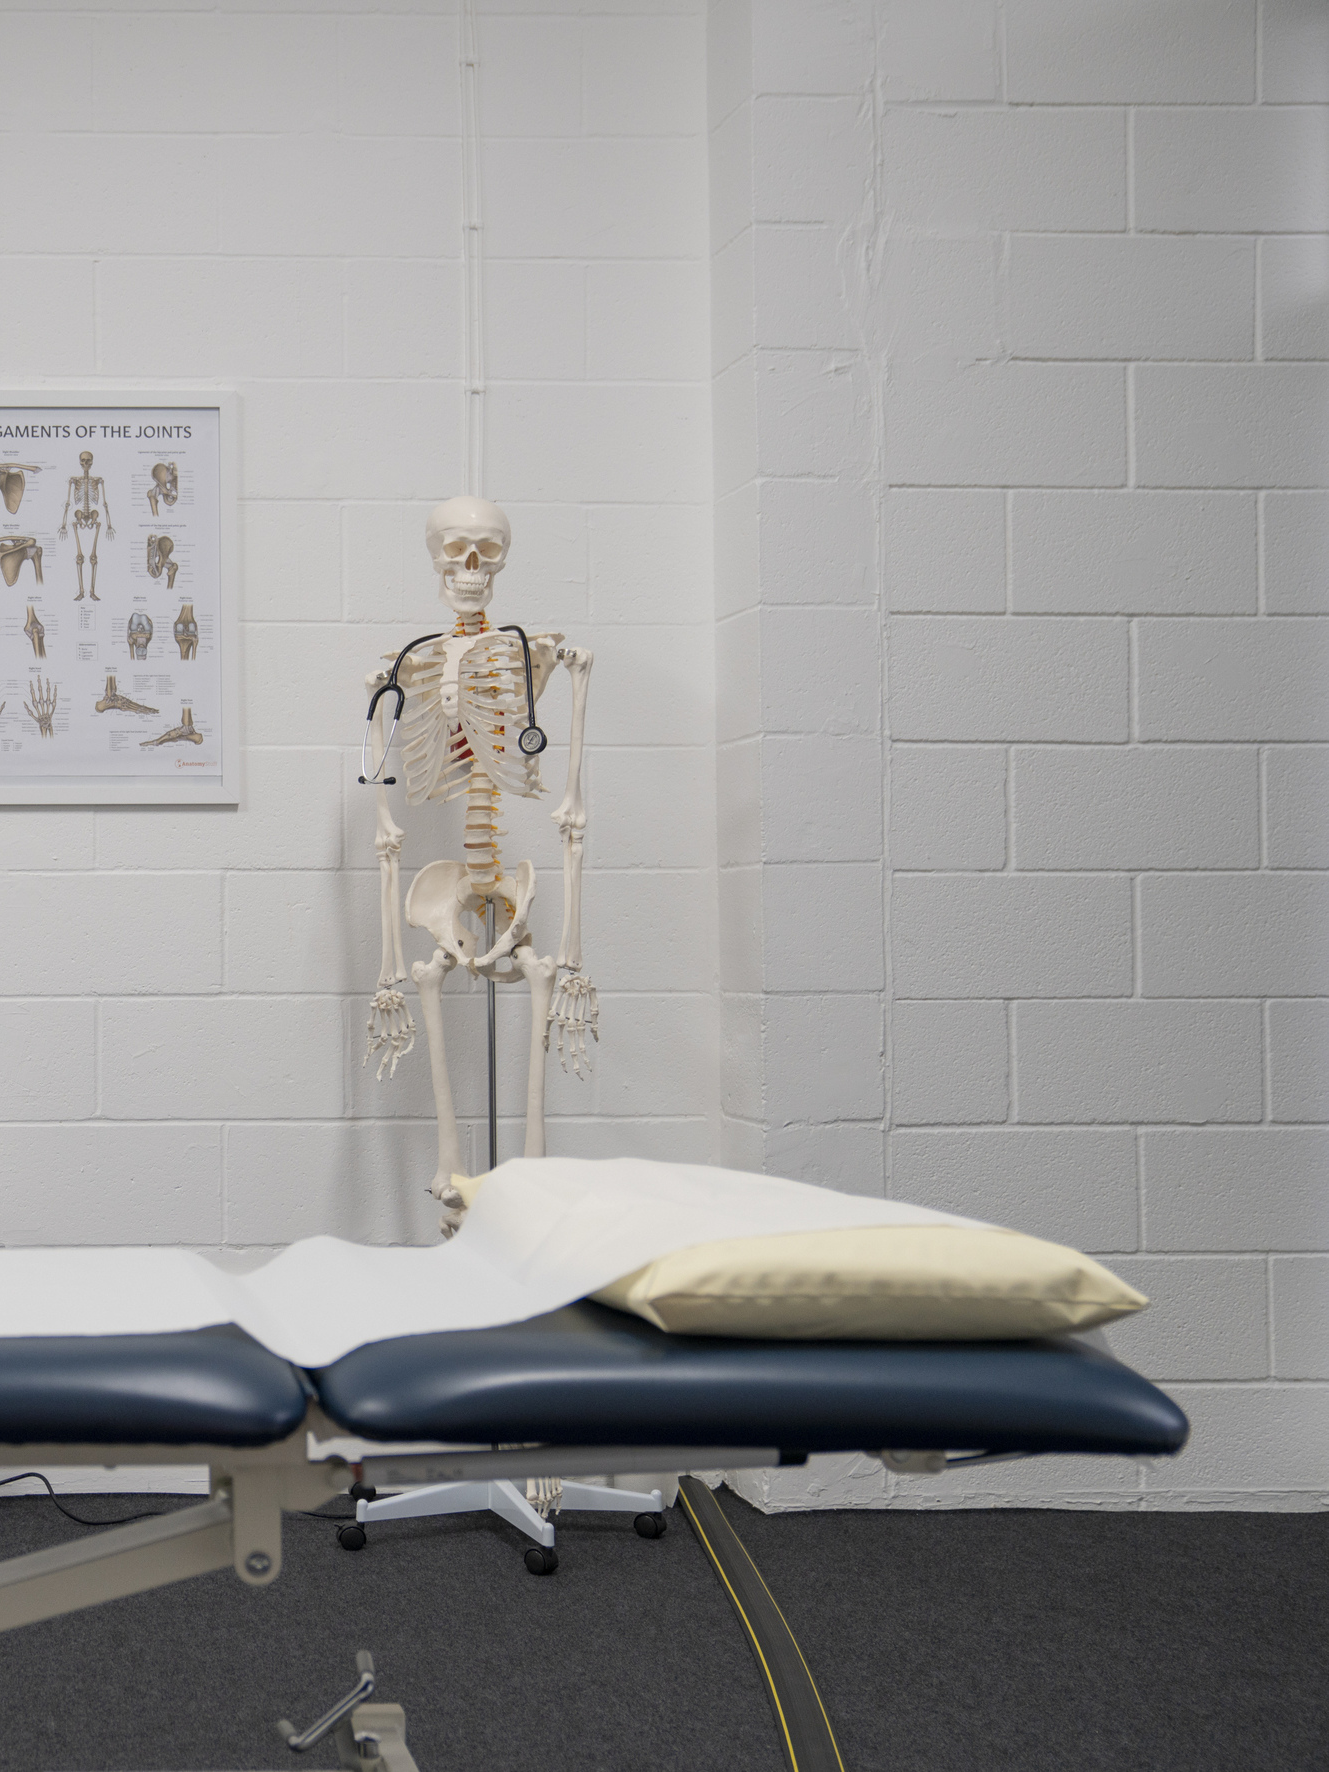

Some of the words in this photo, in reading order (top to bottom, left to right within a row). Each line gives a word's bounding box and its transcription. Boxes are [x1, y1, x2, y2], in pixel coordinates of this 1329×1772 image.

[75, 425, 98, 439] OF
[100, 425, 132, 439] THE
[135, 425, 192, 439] JOINTS
